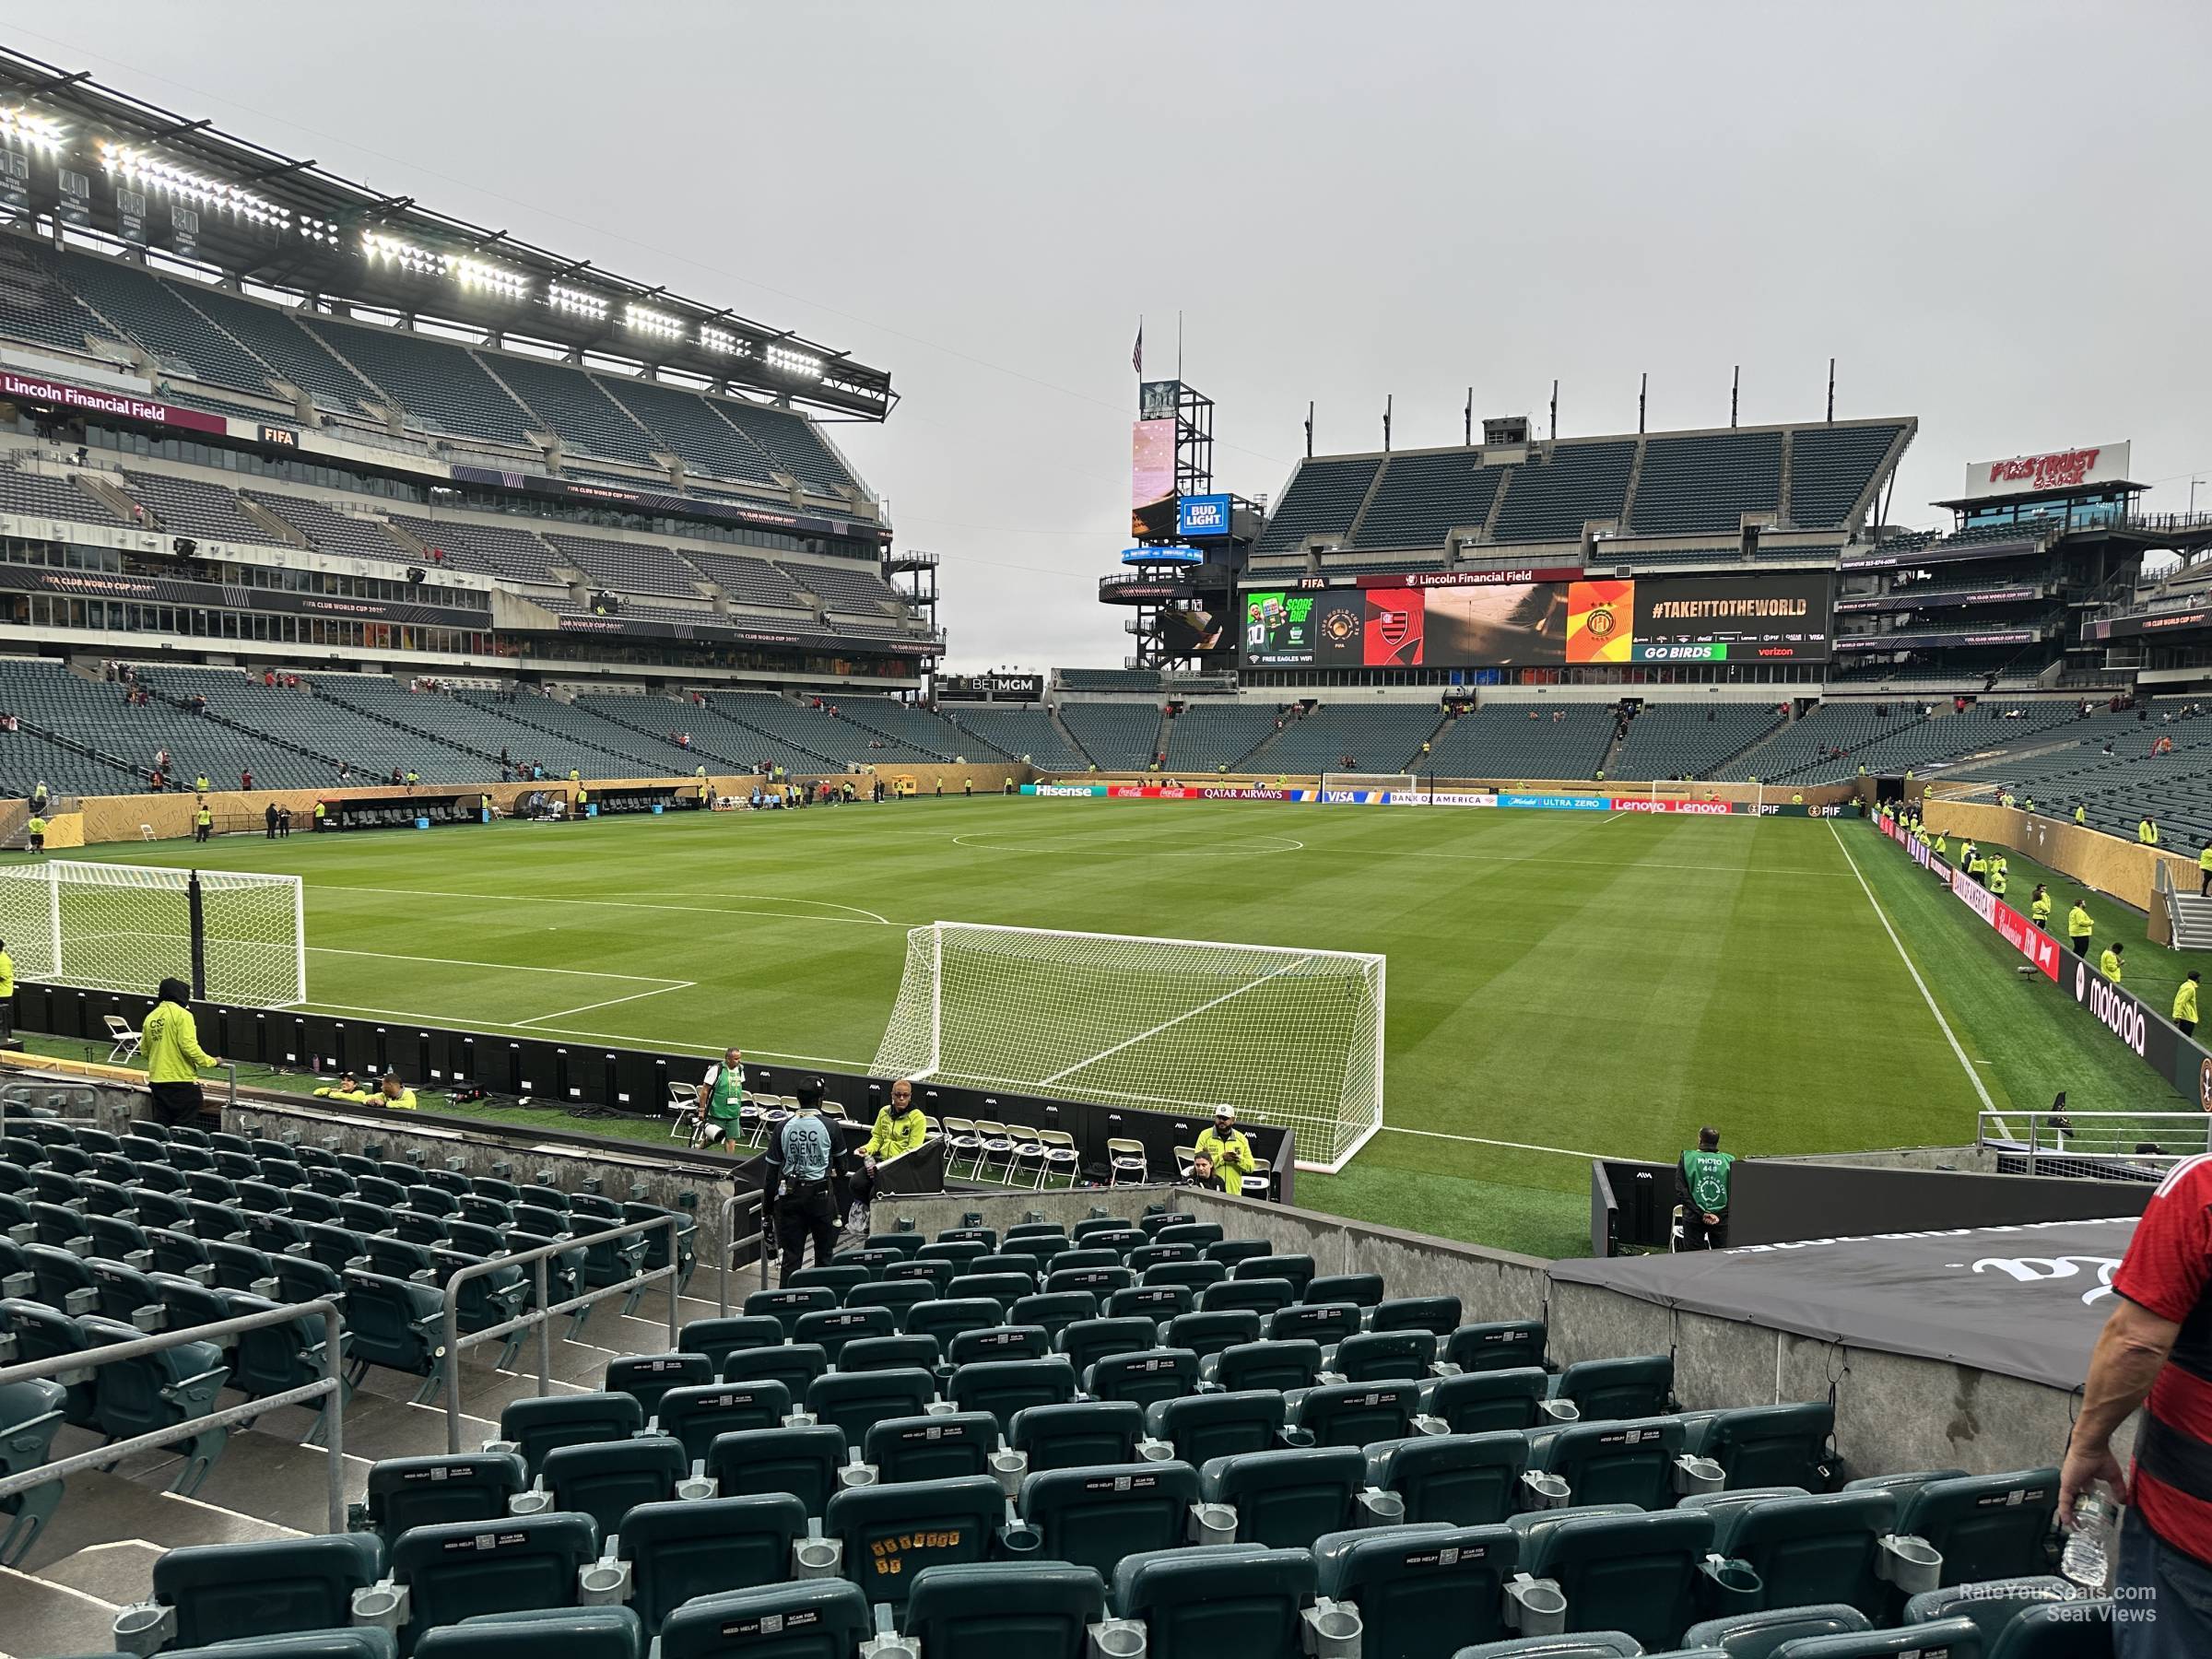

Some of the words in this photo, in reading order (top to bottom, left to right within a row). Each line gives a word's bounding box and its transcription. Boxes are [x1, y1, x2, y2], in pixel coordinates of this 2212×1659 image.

[6, 377, 62, 401] Lincoln
[65, 389, 129, 415] Financial
[133, 403, 165, 421] Field
[265, 428, 294, 445] FIFA
[1191, 505, 1217, 516] BUD
[1186, 514, 1221, 525] LIGHT
[1419, 574, 1456, 584] Lincoln
[1458, 571, 1504, 583] Financial
[1506, 571, 1532, 581] Field
[1301, 579, 1324, 588] FIFA
[1286, 598, 1313, 611] SCORE
[1652, 598, 1806, 618] #TAKEITTOTHEWORLD
[1289, 610, 1308, 622] BIG!
[1645, 647, 1667, 658] GO
[1670, 646, 1712, 658] BIRDS
[1759, 647, 1794, 656] verizon
[973, 678, 1033, 690] BETMGM
[1036, 784, 1092, 796] Hisense
[1118, 787, 1142, 797] Coca-Cola
[1160, 788, 1184, 798] Coca-Cola
[1205, 788, 1238, 799] QATAR
[1241, 790, 1282, 799] AIRWAYS
[1326, 792, 1354, 802] VISA
[1436, 795, 1481, 804] AMERICA
[1543, 798, 1571, 806] ULTRA
[1575, 799, 1599, 807] ZERO
[1615, 799, 1665, 811] Lenovo
[1676, 801, 1727, 813] Lenovo
[1761, 805, 1779, 815] PIF
[1821, 806, 1841, 816] PIF
[2090, 978, 2145, 1057] motorola
[150, 1018, 165, 1029] CSC
[789, 1130, 818, 1143] CSC
[789, 1143, 818, 1156] EVENT
[1697, 1158, 1723, 1166] PHOTO
